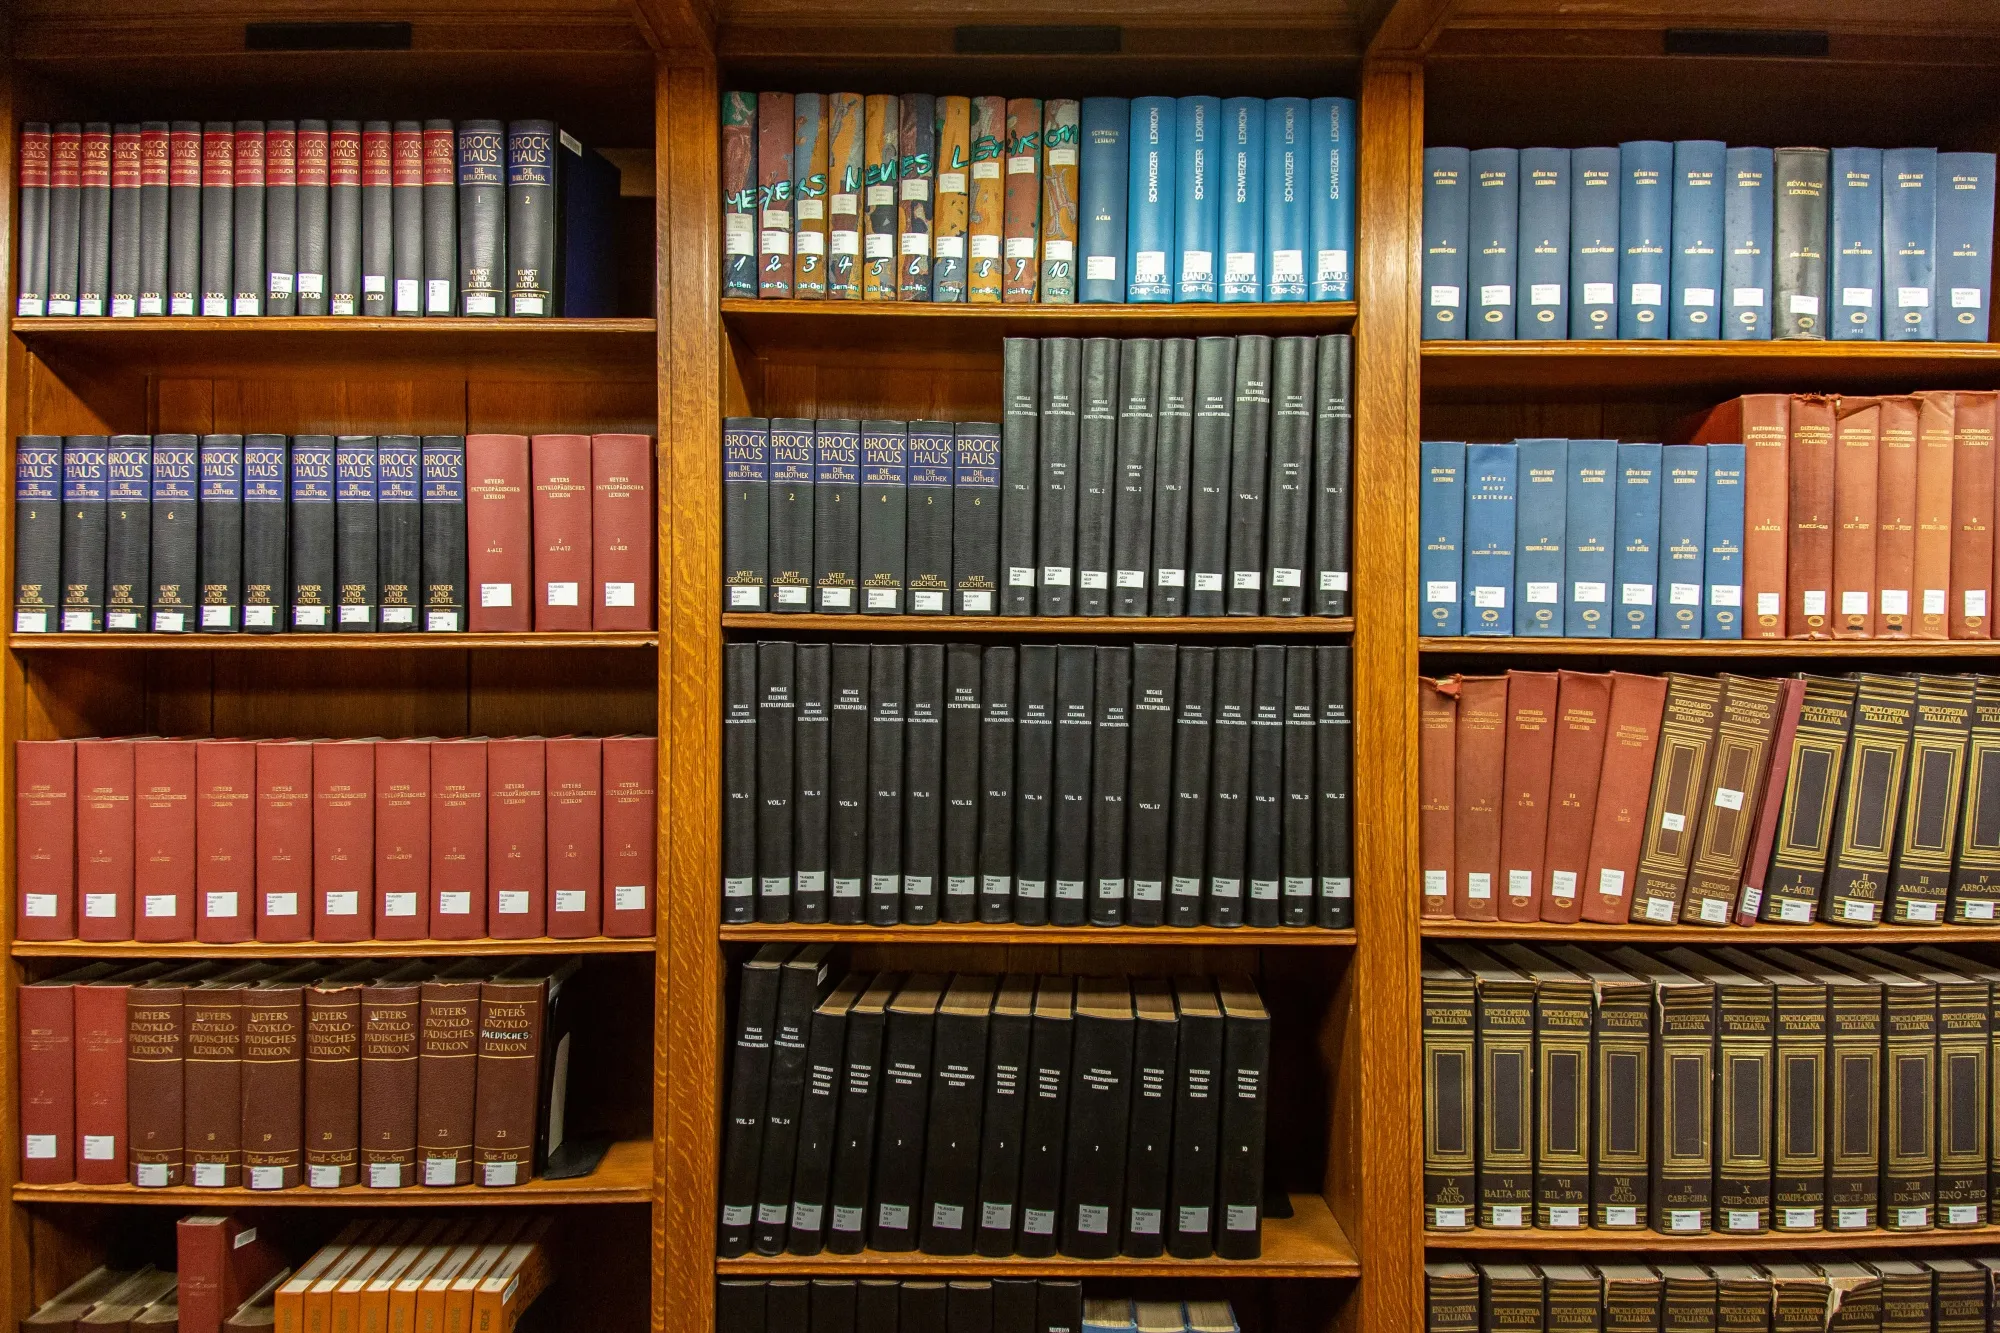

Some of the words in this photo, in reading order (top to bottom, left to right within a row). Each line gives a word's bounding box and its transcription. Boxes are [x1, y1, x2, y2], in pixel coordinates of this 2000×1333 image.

[1150, 107, 1158, 144] LEXIKON
[1196, 105, 1204, 142] LEXIKON
[1239, 108, 1247, 144] LEXIKON
[1331, 105, 1339, 142] LEXIKON
[460, 137, 501, 150] BROCK
[509, 138, 549, 150] BROCK
[463, 150, 497, 162] HAUS
[512, 151, 545, 163] HAUS
[512, 174, 545, 182] BIBLIOTHEK
[1149, 152, 1158, 202] SCHWEIZER
[1195, 149, 1204, 200] SCHWEIZER
[1238, 152, 1246, 202] SCHWEIZER
[1330, 149, 1339, 199] SCHWEIZER
[525, 196, 530, 204] 2
[724, 174, 827, 214] MEYERS
[734, 256, 746, 271] 1
[766, 255, 781, 272] 2
[803, 256, 818, 272] 3
[839, 255, 852, 274] 4
[872, 259, 889, 275] 5
[909, 256, 921, 275] 6
[944, 260, 956, 277] 7
[979, 259, 991, 277] 8
[1049, 261, 1069, 278] 10
[1014, 259, 1026, 281] 9
[1135, 274, 1159, 283] BAND
[1162, 275, 1166, 283] 2
[1182, 272, 1206, 281] BAND
[1208, 273, 1213, 281] 3
[725, 435, 766, 447] BROCK
[772, 436, 813, 448] BROCK
[818, 436, 859, 449] BROCK
[864, 438, 905, 450] BROCK
[911, 439, 952, 452] BROCK
[958, 440, 999, 452] BROCK
[16, 453, 58, 465] BROCK
[65, 453, 106, 465] BROCK
[108, 453, 148, 464] BROCK
[153, 452, 195, 464] BROCK
[729, 448, 763, 460] HAUS
[776, 449, 809, 461] HAUS
[822, 450, 855, 462] HAUS
[868, 451, 901, 463] HAUS
[914, 452, 947, 464] HAUS
[961, 452, 995, 465] HAUS
[19, 465, 53, 478] HAUS
[66, 465, 100, 477] HAUS
[110, 465, 143, 477] HAUS
[156, 465, 190, 477] HAUS
[835, 494, 840, 502] 3
[121, 511, 126, 519] 5
[727, 576, 763, 584] GESCHICHTE
[911, 580, 947, 588] GESCHICHTE
[1732, 700, 1768, 711] DIZIONARIO
[1860, 705, 1909, 718] ENCICLOPEDIA
[1918, 705, 1968, 718] ENCICLOPEDIA
[1725, 706, 1770, 719] ENCICLOPEDICO
[1732, 715, 1761, 724] ITALIANO
[1865, 714, 1903, 725] ITALIANA
[1924, 714, 1962, 724] ITALIANA
[1701, 881, 1730, 891] SECONDO
[1850, 880, 1878, 891] AGRO
[1646, 888, 1676, 898] MENTO
[1849, 888, 1875, 899] AMMI
[430, 1007, 466, 1016] MEYERS
[1426, 1009, 1472, 1017] ENCICLOPEDIA
[1942, 1013, 1986, 1021] ENCICLOPEDIA
[1432, 1017, 1467, 1025] ITALIANA
[482, 1030, 529, 1040] PAEDISCHES
[427, 1041, 469, 1050] LEXIKON
[485, 1043, 527, 1051] LEXIKON
[323, 1132, 332, 1140] 20
[382, 1132, 390, 1140] 21
[496, 1130, 506, 1138] 23
[1447, 1178, 1454, 1186] V
[1504, 1179, 1513, 1188] VI
[1559, 1179, 1571, 1188] VII
[1955, 1180, 1972, 1189] XIV
[1441, 1187, 1459, 1195] ASSI
[1437, 1194, 1465, 1203] BALSO
[1609, 1194, 1636, 1203] CARD
[1615, 1314, 1651, 1323] ITALIANA
